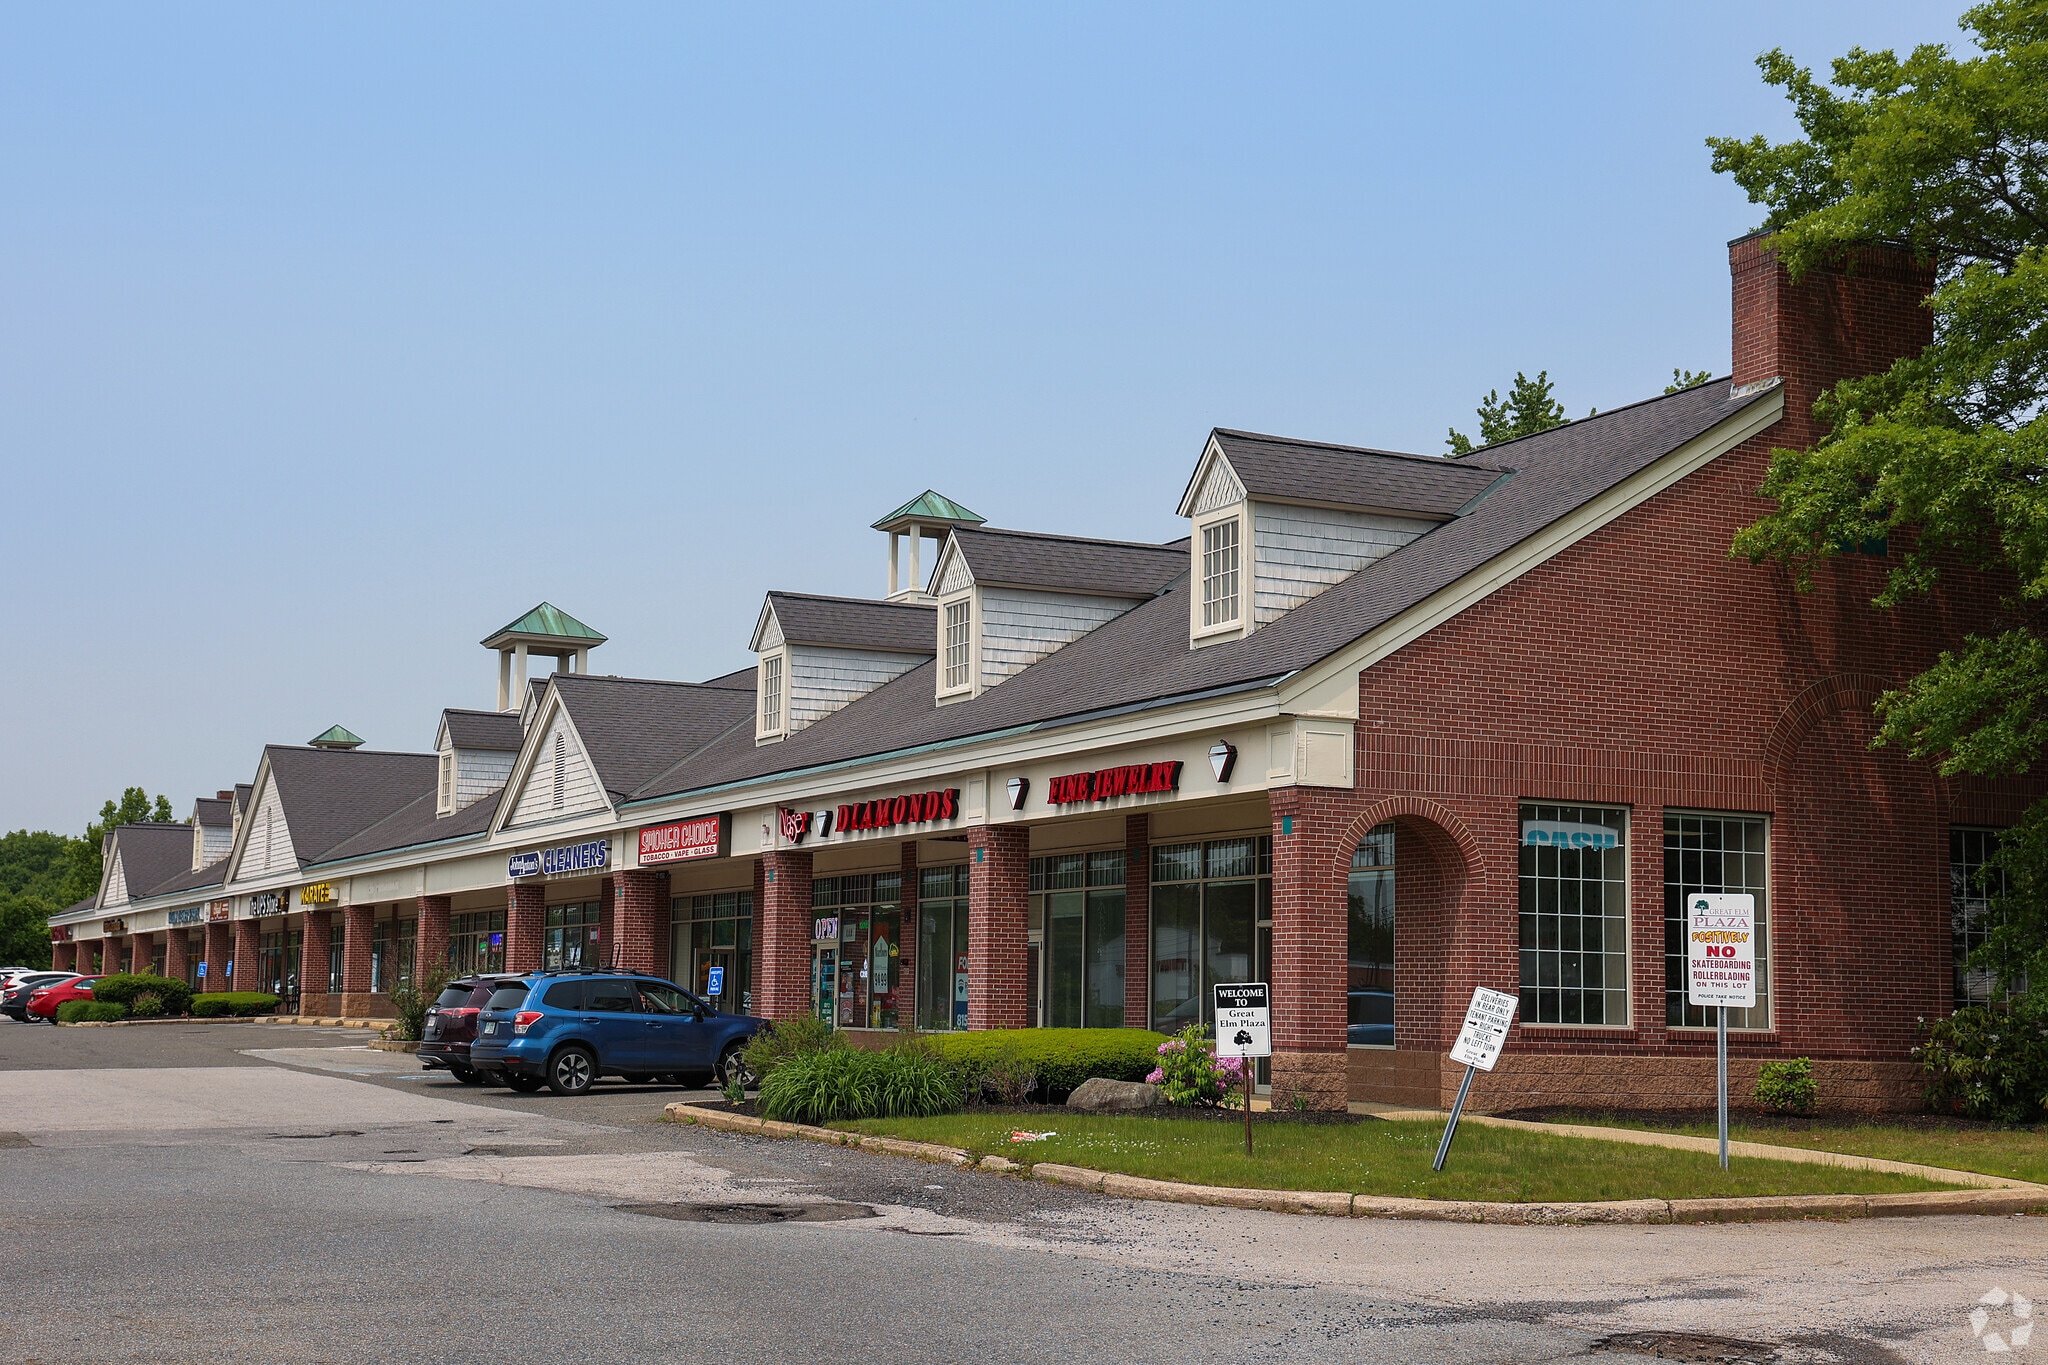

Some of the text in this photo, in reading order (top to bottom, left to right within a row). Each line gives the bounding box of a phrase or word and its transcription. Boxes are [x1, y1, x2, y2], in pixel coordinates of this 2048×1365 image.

[1047, 760, 1178, 804] FINE JEWELRY
[835, 788, 956, 833] DIAMONDS
[681, 820, 717, 847] CHOICE
[1526, 829, 1615, 851] CASH
[542, 839, 607, 875] CLEANERS
[642, 846, 715, 862] TOBACCO VAPE GLASS
[301, 883, 331, 905] KARATE
[815, 917, 838, 939] OPEN
[1693, 916, 1749, 927] PLAZA
[1691, 930, 1750, 944] POSITIVELY
[1706, 945, 1736, 958] NO
[957, 956, 968, 970] FO
[1691, 959, 1751, 970] SKATEBOARDING
[1693, 970, 1750, 981] ROLLERBLADING
[1218, 988, 1264, 998] WELCOME
[1234, 998, 1248, 1007] TO
[1480, 993, 1510, 1008] DELIVERIES
[1229, 1009, 1255, 1018] Great
[1474, 1000, 1510, 1016] IN REAR ONLY
[1220, 1019, 1266, 1028] Elm Plaza
[1470, 1010, 1509, 1028] TENANT PARKING
[1479, 1021, 1494, 1032] RIGHT
[1473, 1030, 1492, 1043] TRUCKS
[1463, 1036, 1496, 1052] NO LEFT TURN
